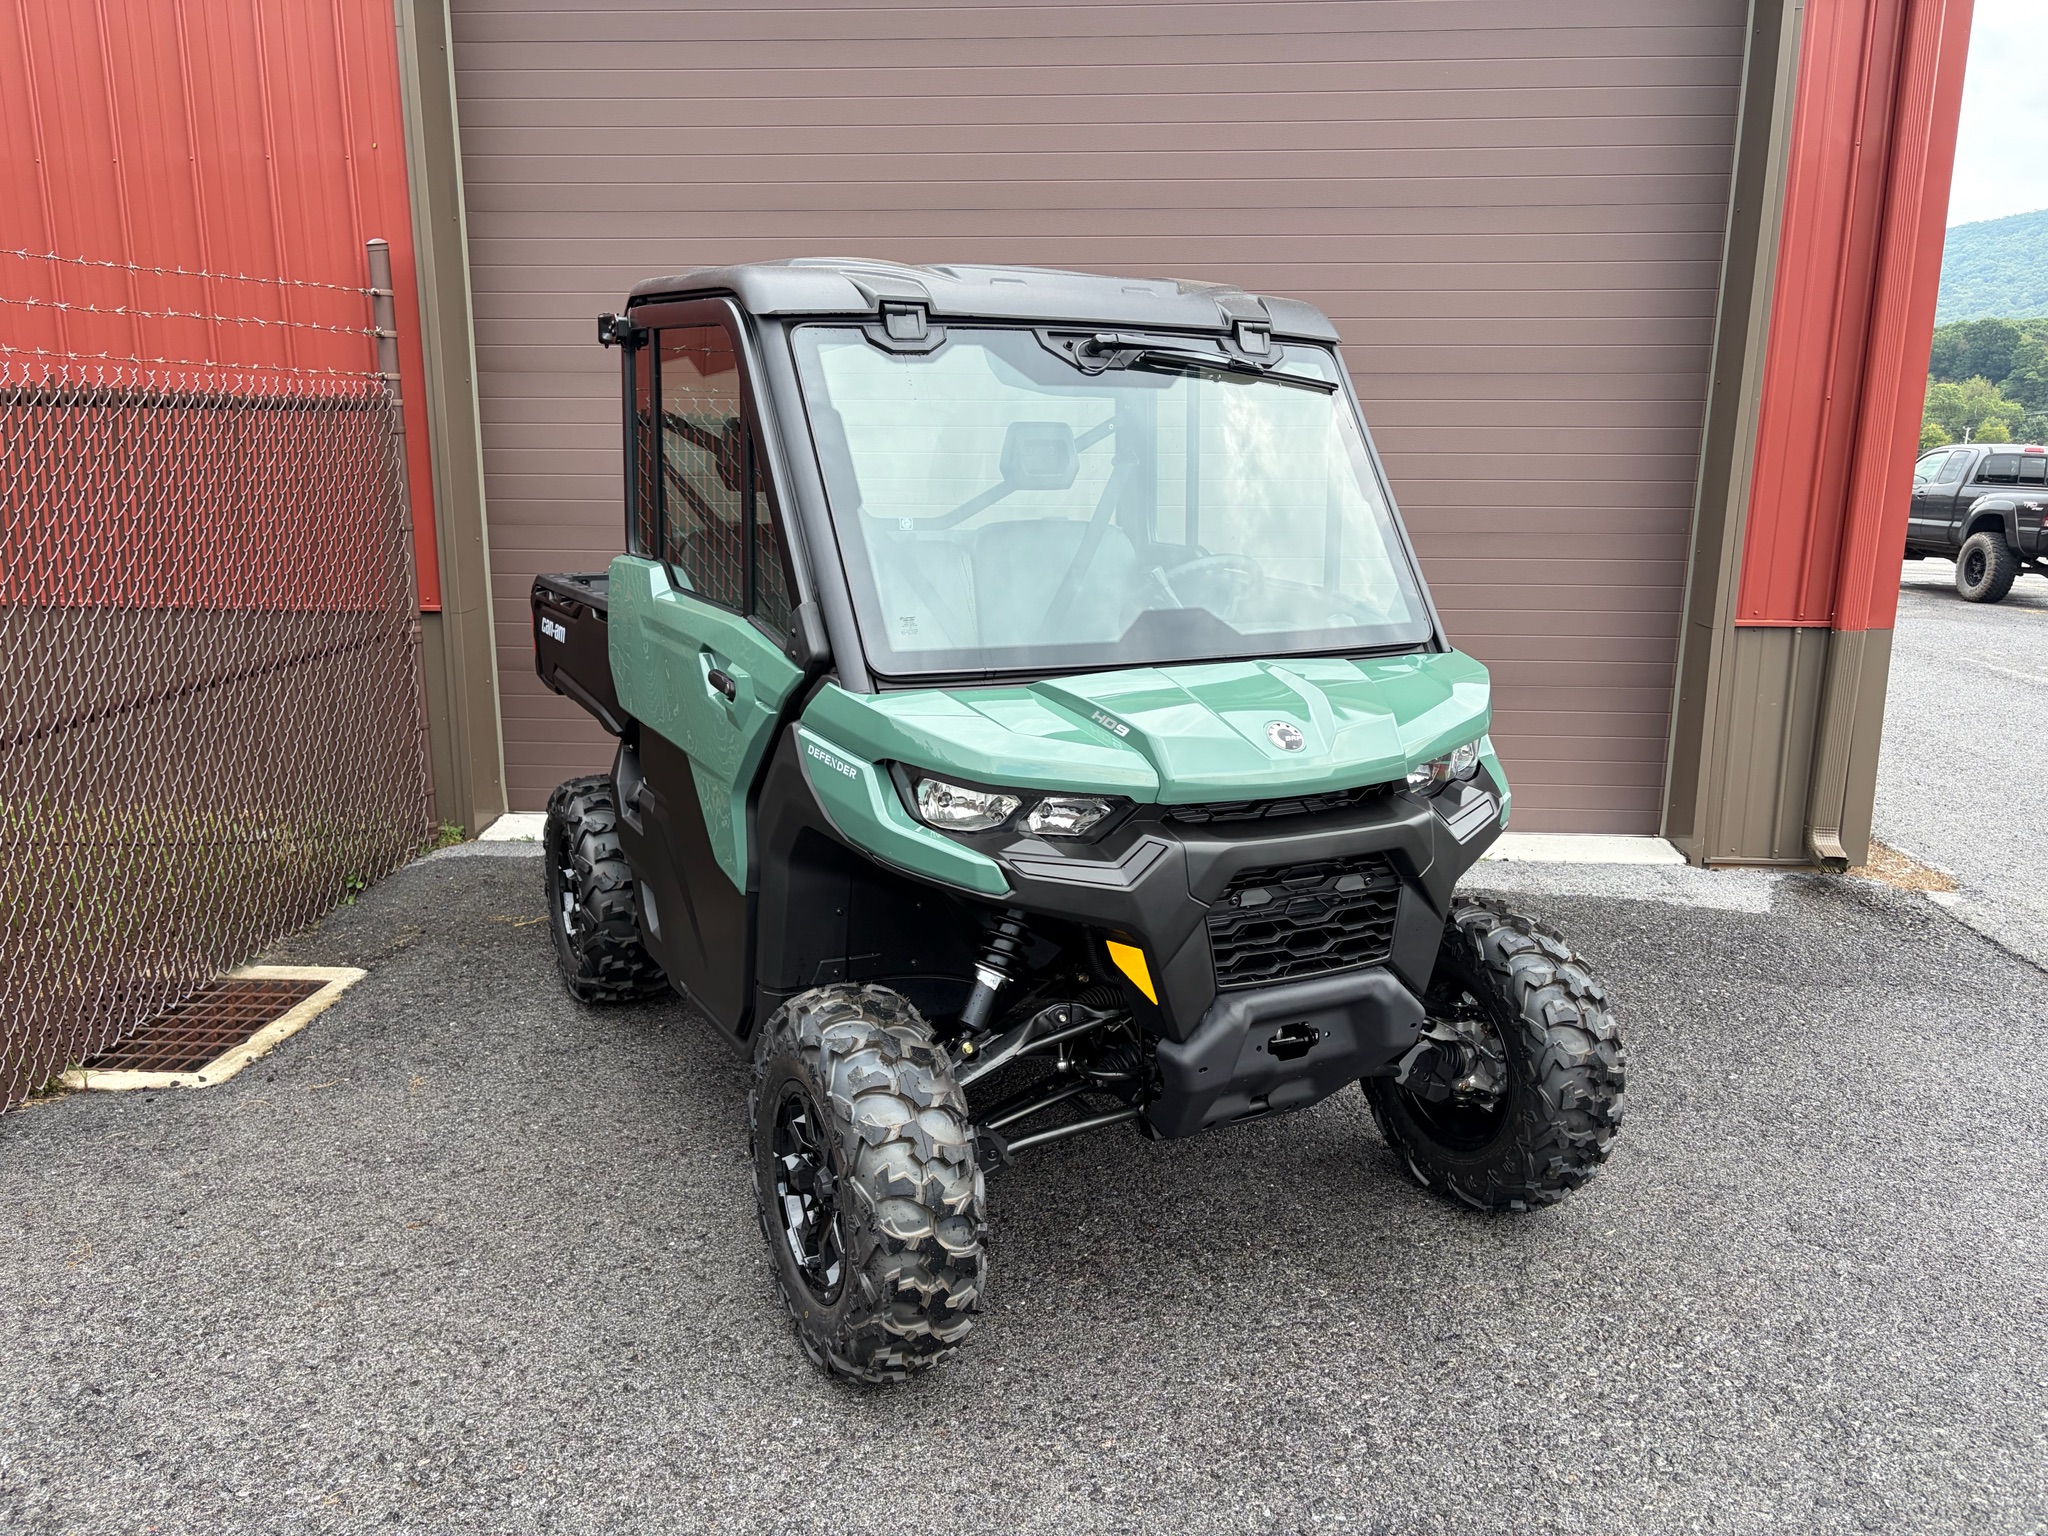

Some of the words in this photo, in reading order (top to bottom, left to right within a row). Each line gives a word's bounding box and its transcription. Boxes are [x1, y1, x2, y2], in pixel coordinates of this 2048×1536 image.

[541, 616, 566, 644] can-am
[1091, 710, 1130, 737] HD9
[807, 744, 857, 780] DEFENDER
